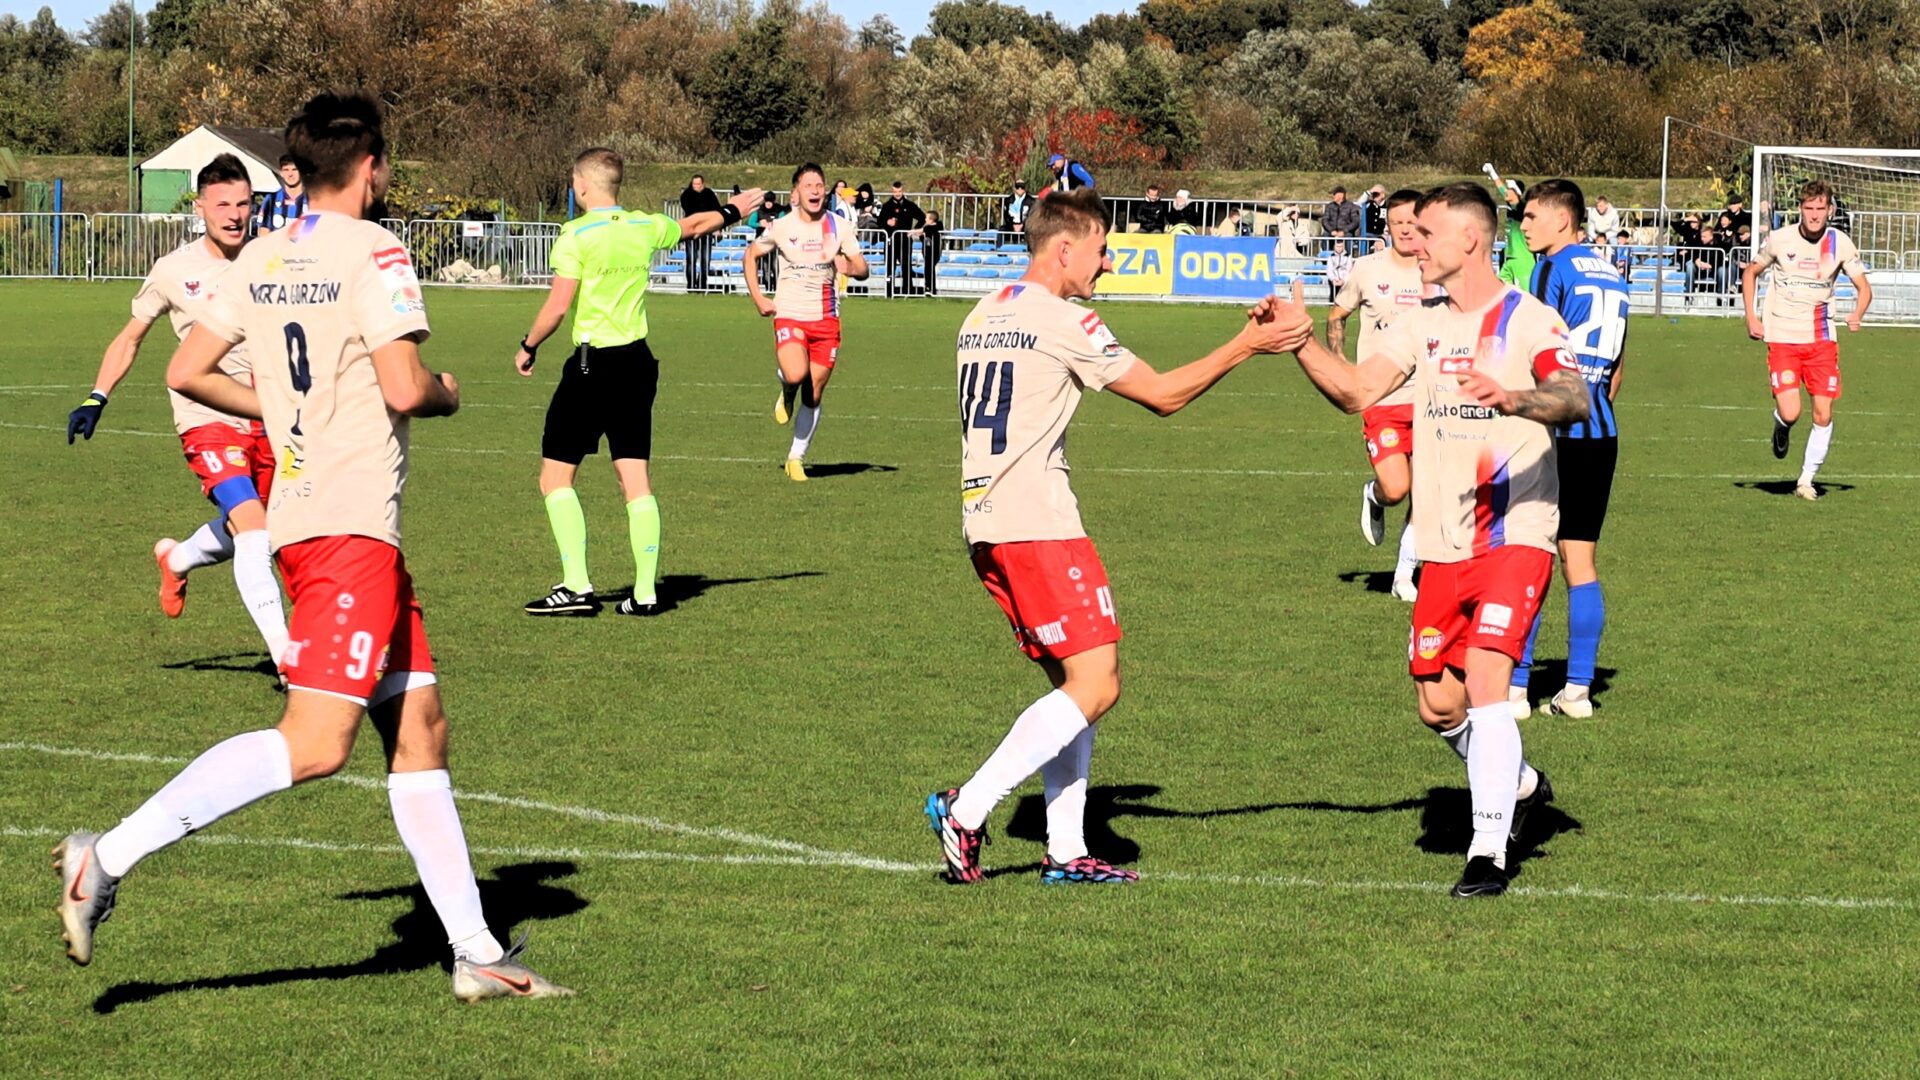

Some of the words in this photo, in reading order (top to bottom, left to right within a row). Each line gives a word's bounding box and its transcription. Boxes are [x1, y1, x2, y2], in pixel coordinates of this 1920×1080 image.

[1180, 251, 1270, 282] ODRA
[984, 328, 1038, 350] GORZÓW
[201, 450, 223, 473] 8
[345, 631, 374, 681] 9
